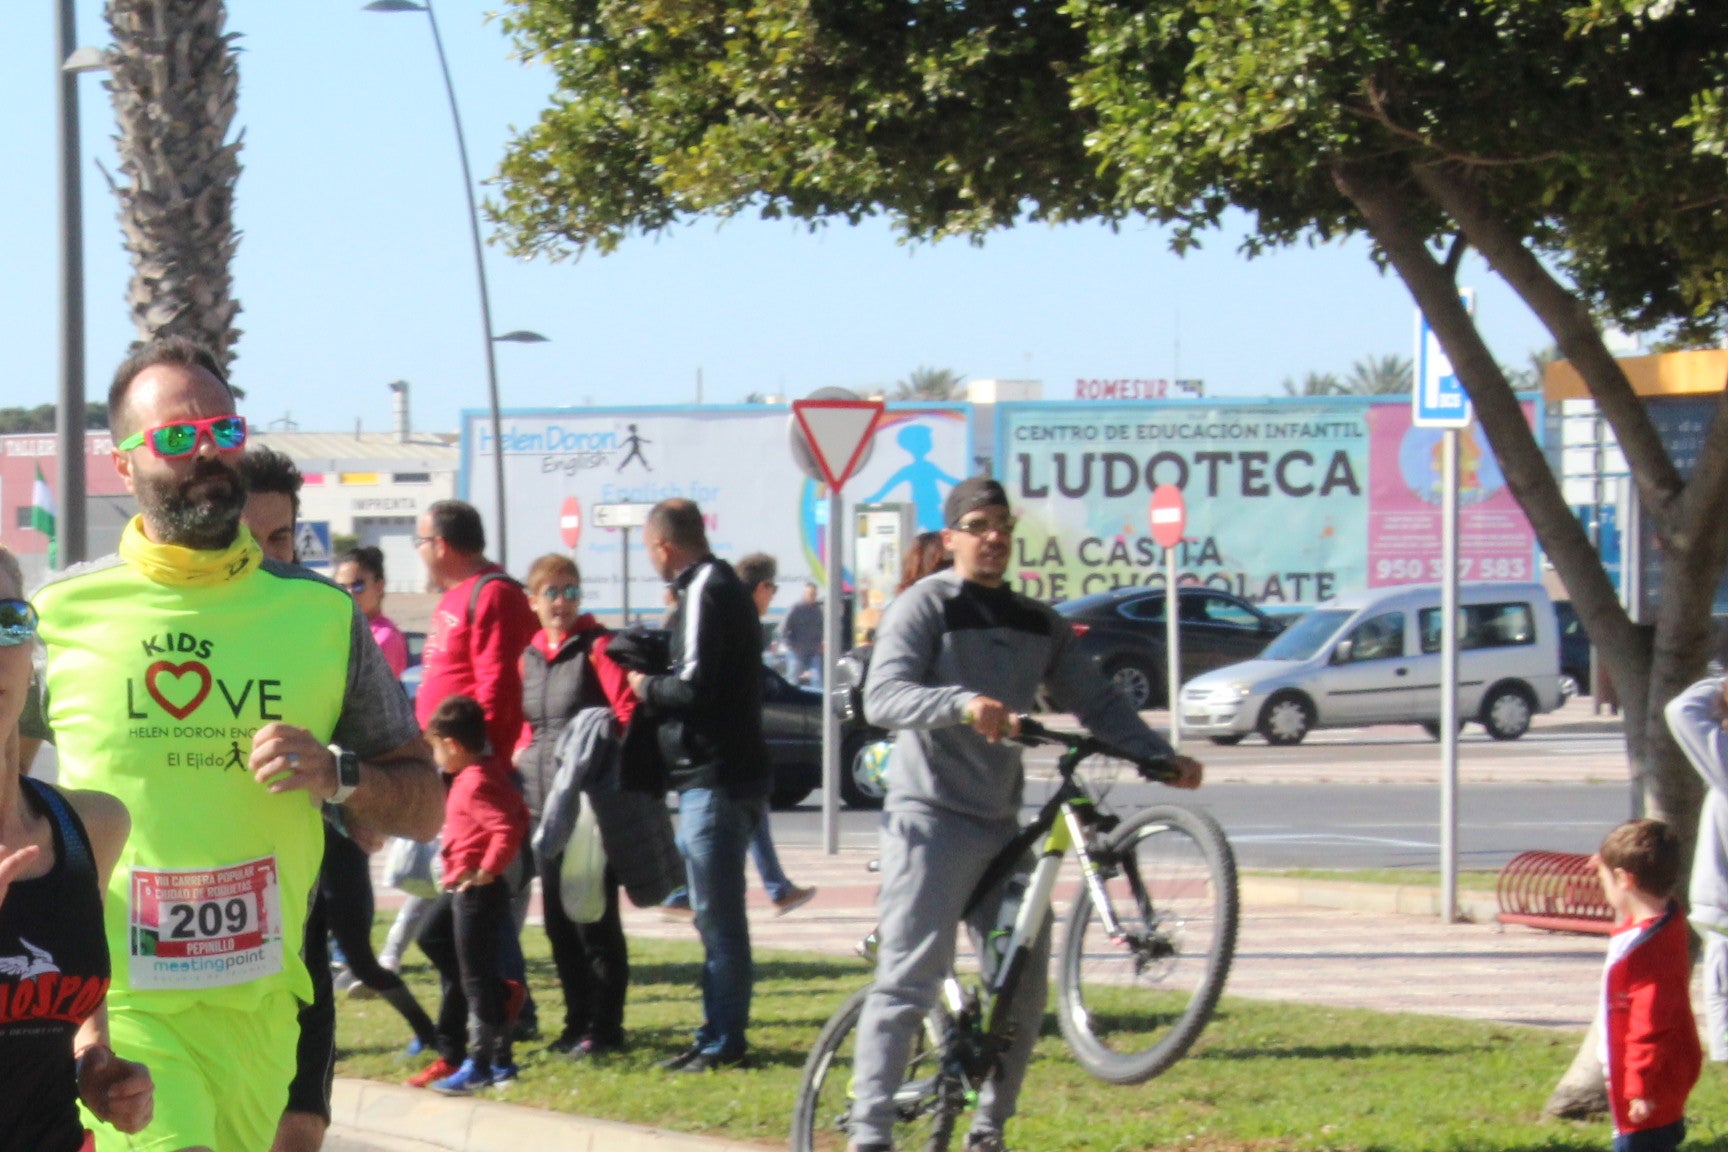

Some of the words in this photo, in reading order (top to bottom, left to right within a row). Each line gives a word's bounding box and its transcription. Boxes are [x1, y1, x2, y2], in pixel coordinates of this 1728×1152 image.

[1076, 379, 1168, 399] ROMESUR
[546, 425, 616, 450] Doron
[1015, 425, 1097, 440] CENTRO
[1104, 425, 1130, 439] DE
[1136, 421, 1258, 439] EDUCACIÓN
[1265, 422, 1362, 438] INFANTIL
[1017, 450, 1360, 498] LUDOTECA
[1017, 537, 1064, 567] LA
[1376, 558, 1422, 579] 950
[1428, 557, 1474, 579] 37
[1480, 557, 1526, 578] 583
[1020, 573, 1067, 601] DE
[141, 632, 214, 659] KIDS
[129, 727, 169, 738] HELEN
[173, 727, 225, 738] DORON
[167, 753, 181, 767] El
[186, 752, 225, 769] Ejido
[170, 897, 248, 939] 209
[186, 937, 236, 956] PEPINILLO
